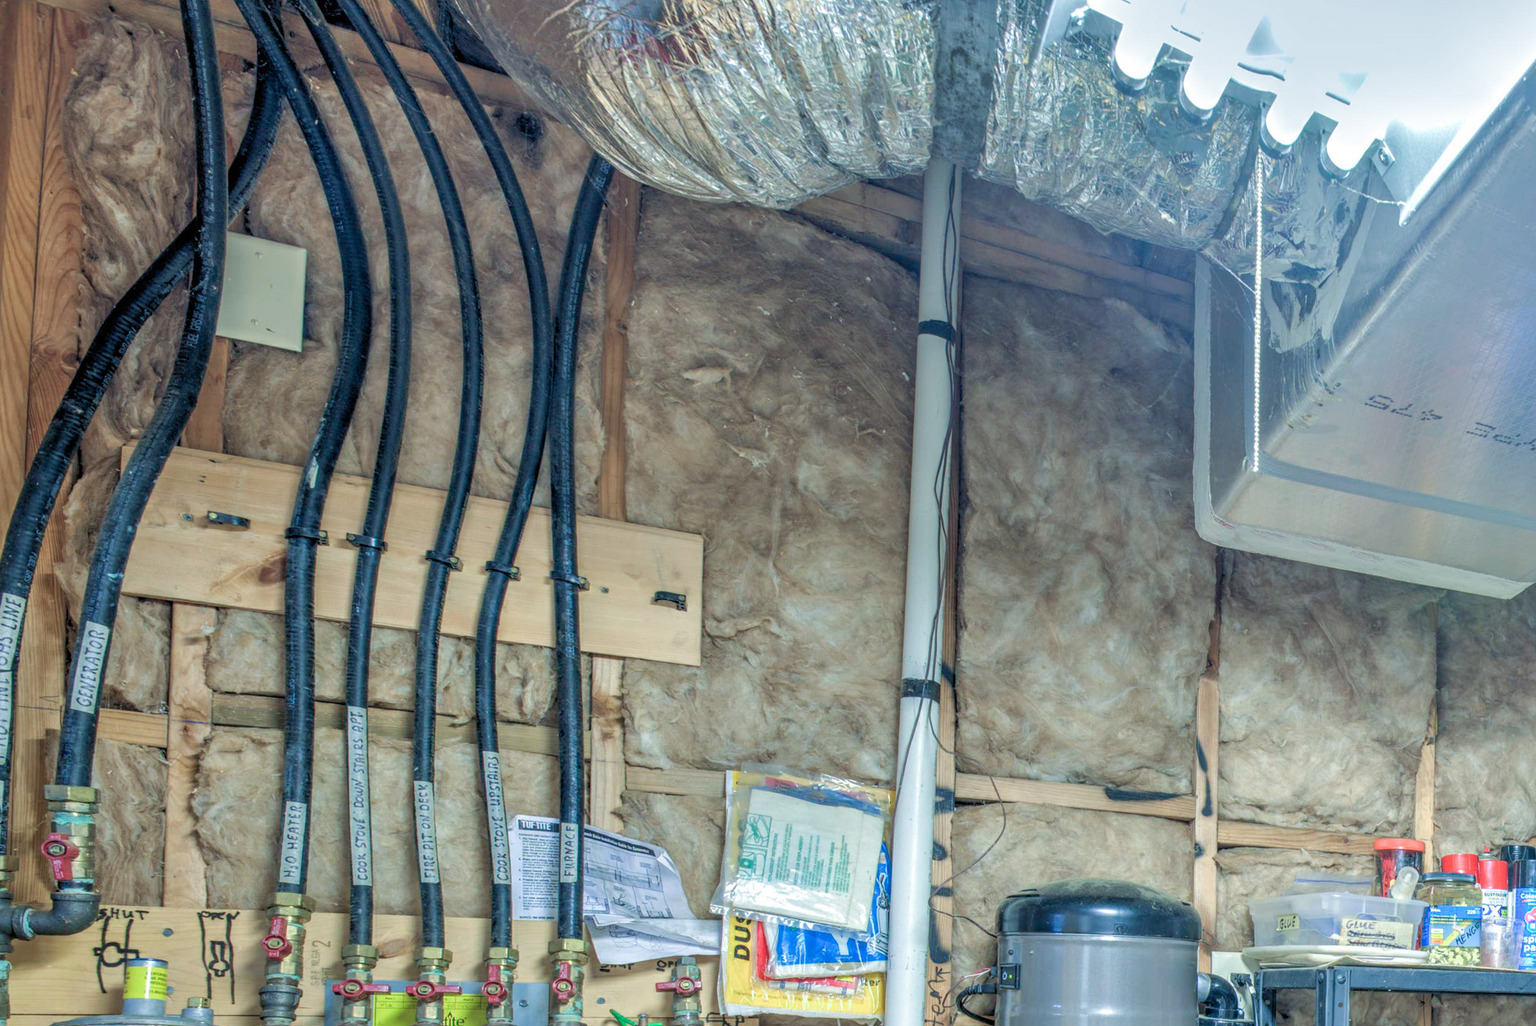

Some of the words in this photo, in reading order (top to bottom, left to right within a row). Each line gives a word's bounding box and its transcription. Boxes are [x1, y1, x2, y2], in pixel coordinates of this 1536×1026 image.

[76, 628, 106, 708] GENERATOR
[352, 739, 366, 775] STAIRS
[353, 778, 366, 808] DOWN
[485, 755, 503, 808] UPSTAIRS
[416, 783, 430, 812] DECK
[286, 805, 303, 852] HEATER
[419, 813, 432, 830] ON
[420, 832, 435, 852] PIT
[563, 825, 577, 878] FURNACE
[355, 854, 368, 881] COOK
[422, 854, 437, 880] FIRE
[494, 852, 510, 881] COOK
[1279, 916, 1297, 930] GLUE
[1346, 920, 1376, 930] GLUE
[1454, 921, 1481, 946] MENGE
